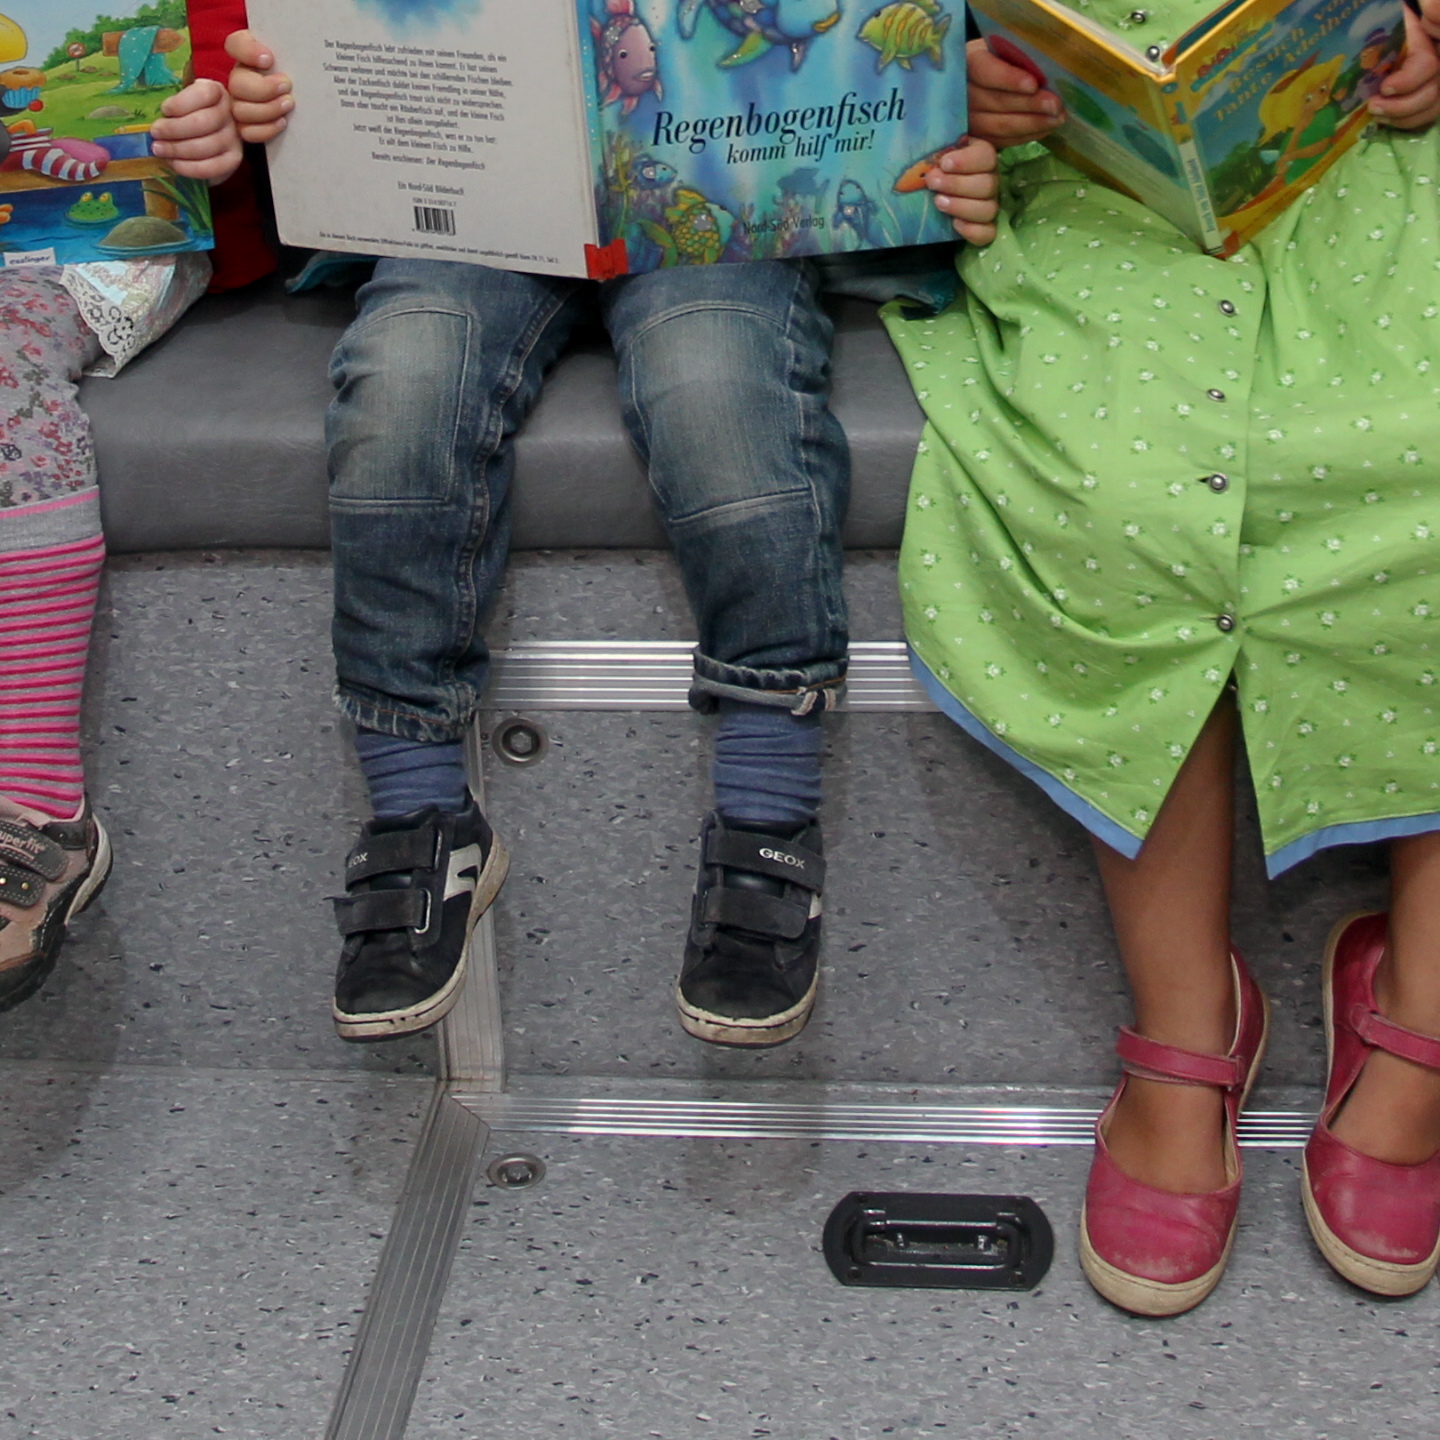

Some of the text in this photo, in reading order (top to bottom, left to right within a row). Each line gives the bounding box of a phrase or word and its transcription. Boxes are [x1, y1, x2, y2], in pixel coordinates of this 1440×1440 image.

[335, 40, 383, 53] Regenbogenfisch
[1228, 27, 1306, 96] Besuch
[1214, 71, 1274, 123] Tante
[651, 87, 907, 155] Regenbogenfisch
[726, 128, 876, 165] komm hilf mir!
[434, 184, 465, 196] Bilderbuch
[742, 215, 826, 235] Nord-Süd Verlag
[8, 253, 51, 265] esslinger
[758, 846, 806, 871] GEOX
